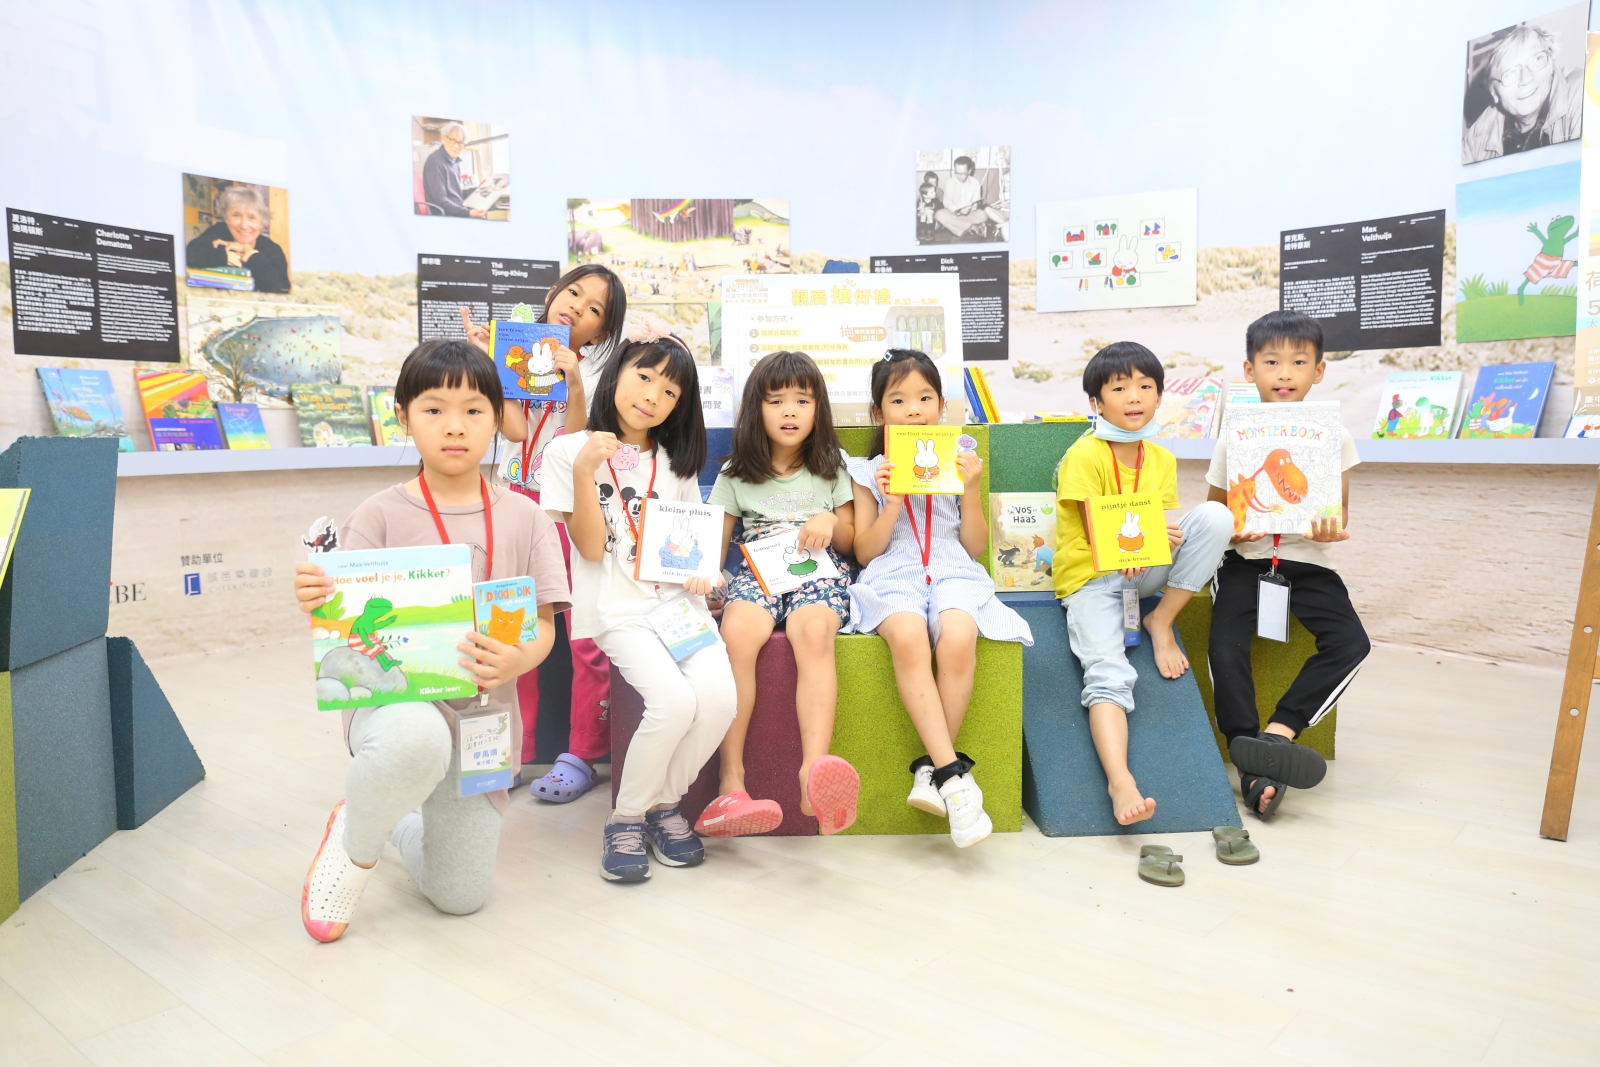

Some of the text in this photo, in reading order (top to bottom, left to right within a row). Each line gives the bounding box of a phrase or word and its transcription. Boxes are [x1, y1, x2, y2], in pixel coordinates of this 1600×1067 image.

[96, 228, 130, 241] Charlotte
[1362, 226, 1377, 234] Max
[1362, 232, 1392, 242] Velthuijs
[96, 238, 132, 250] Dematons
[491, 261, 504, 269] Thé
[491, 268, 528, 278] Tjong-Khing
[1587, 319, 1600, 330] 太
[1236, 425, 1324, 441] MONSTER BOOK
[760, 490, 816, 509] BELIEVE
[659, 505, 686, 514] kleine
[782, 504, 797, 513] IN
[1101, 501, 1127, 510] nijntje
[180, 553, 224, 566] 贊助單位
[355, 573, 378, 583] voel
[381, 574, 390, 584] je
[394, 572, 406, 582] je,
[408, 569, 451, 580] Kikker?
[419, 687, 444, 695] Kikker
